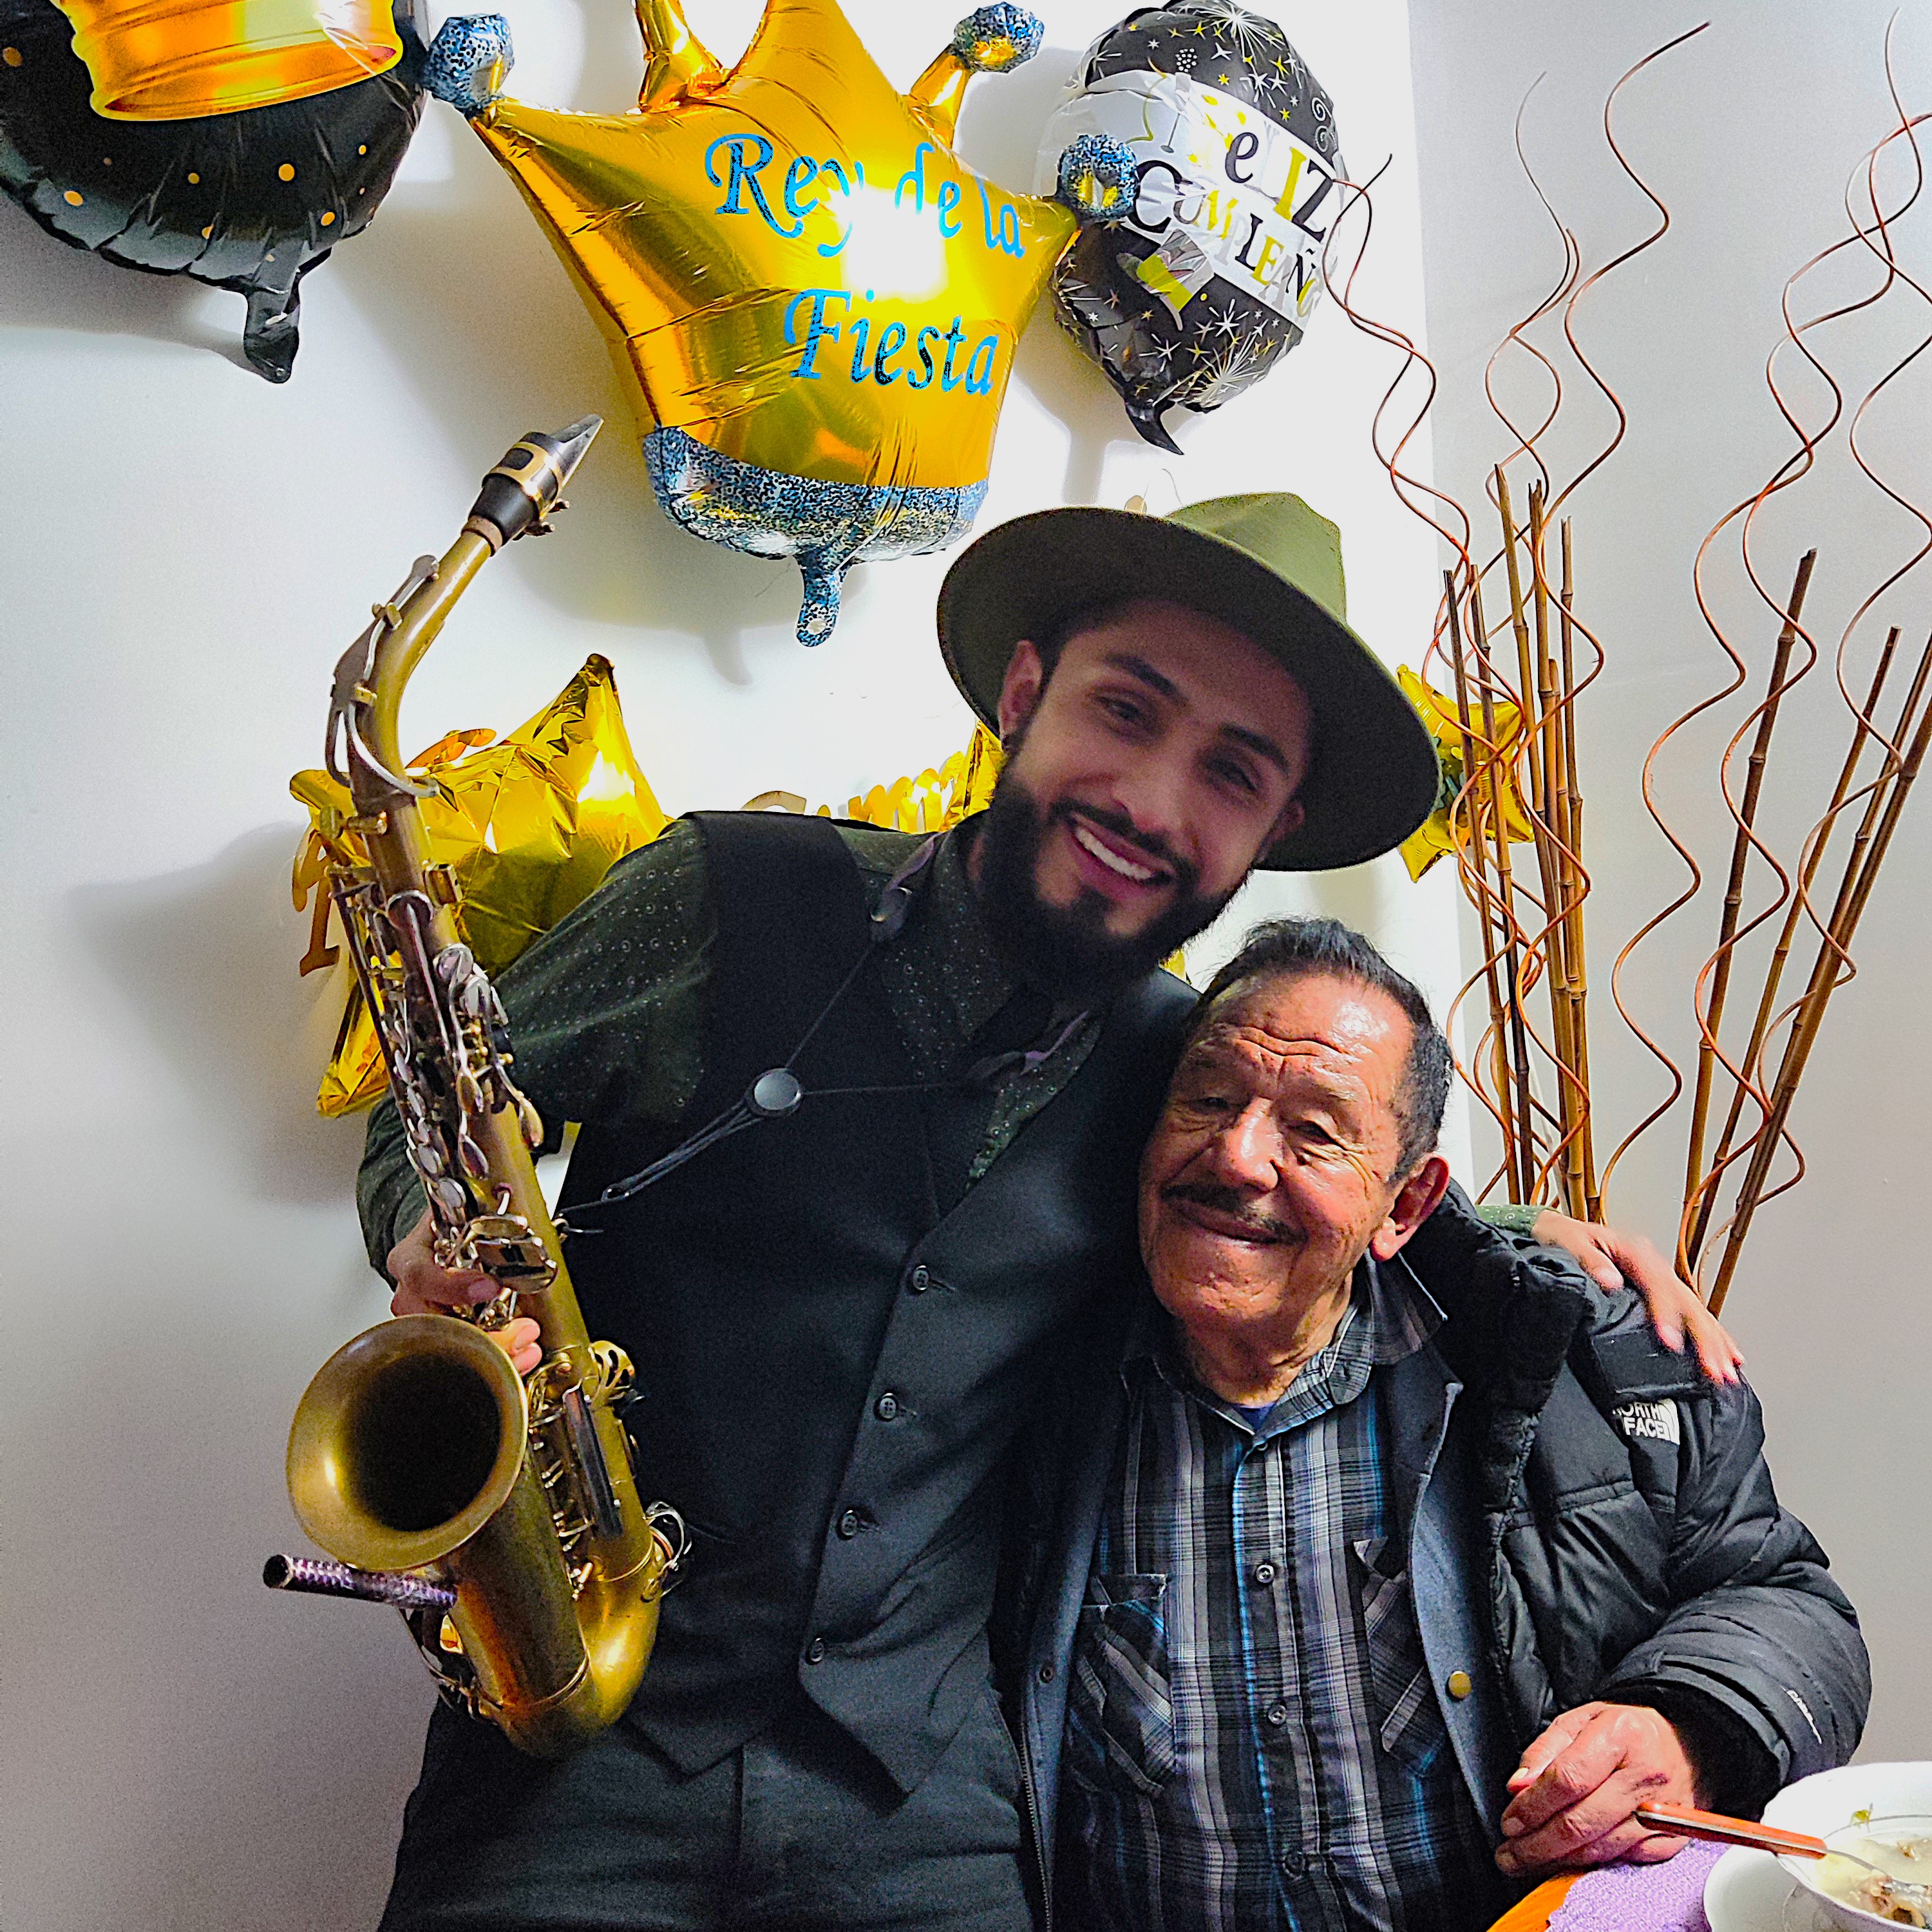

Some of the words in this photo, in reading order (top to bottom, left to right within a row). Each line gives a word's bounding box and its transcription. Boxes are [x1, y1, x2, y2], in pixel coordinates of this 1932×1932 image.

[705, 133, 864, 258] Rey
[895, 142, 962, 238] de
[973, 173, 1027, 260] la
[783, 288, 1000, 396] Fiesta
[1624, 1417, 1666, 1439] FACE
